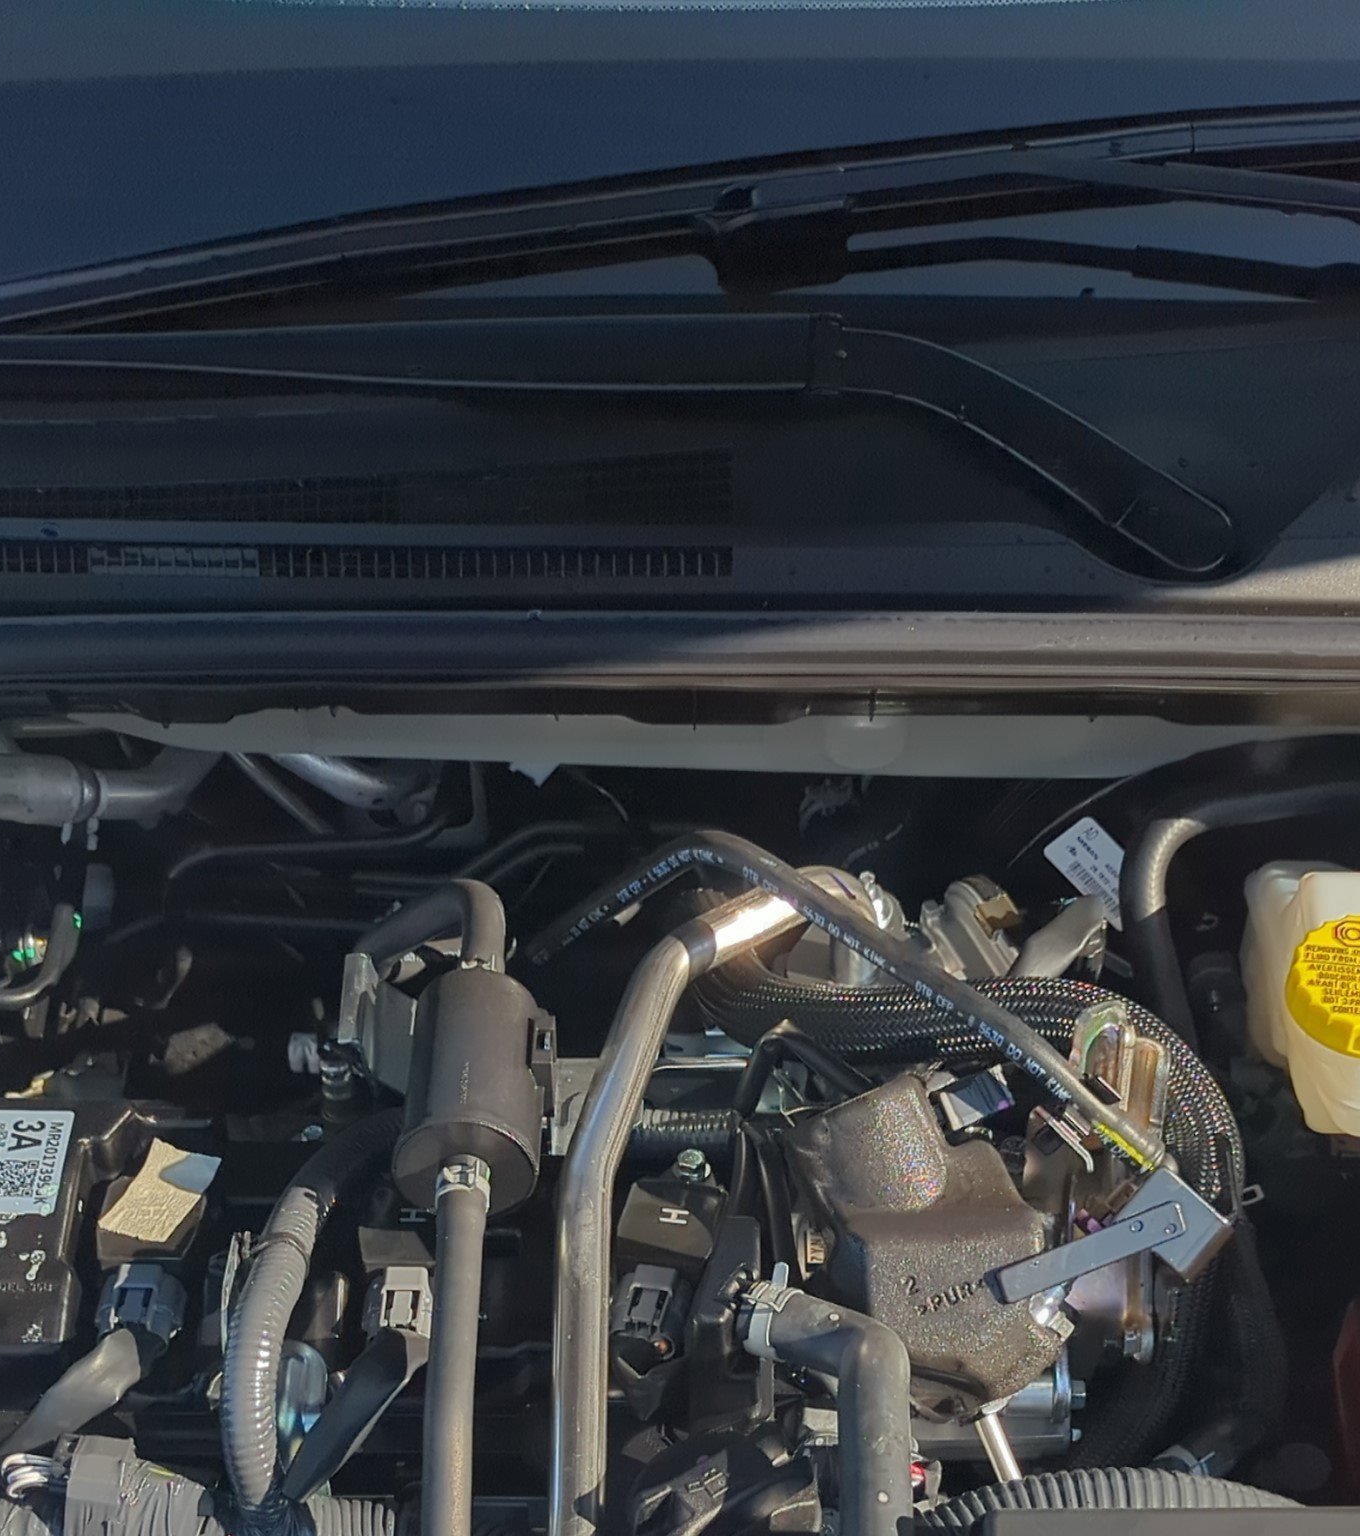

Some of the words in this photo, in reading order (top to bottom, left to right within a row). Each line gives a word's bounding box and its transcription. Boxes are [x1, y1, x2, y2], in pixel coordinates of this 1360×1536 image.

[977, 1021, 1004, 1048] 5630
[1006, 1043, 1022, 1061] DO
[1024, 1058, 1046, 1079] NOT
[1045, 1075, 1073, 1101] KINK
[7, 1120, 46, 1151] 3A
